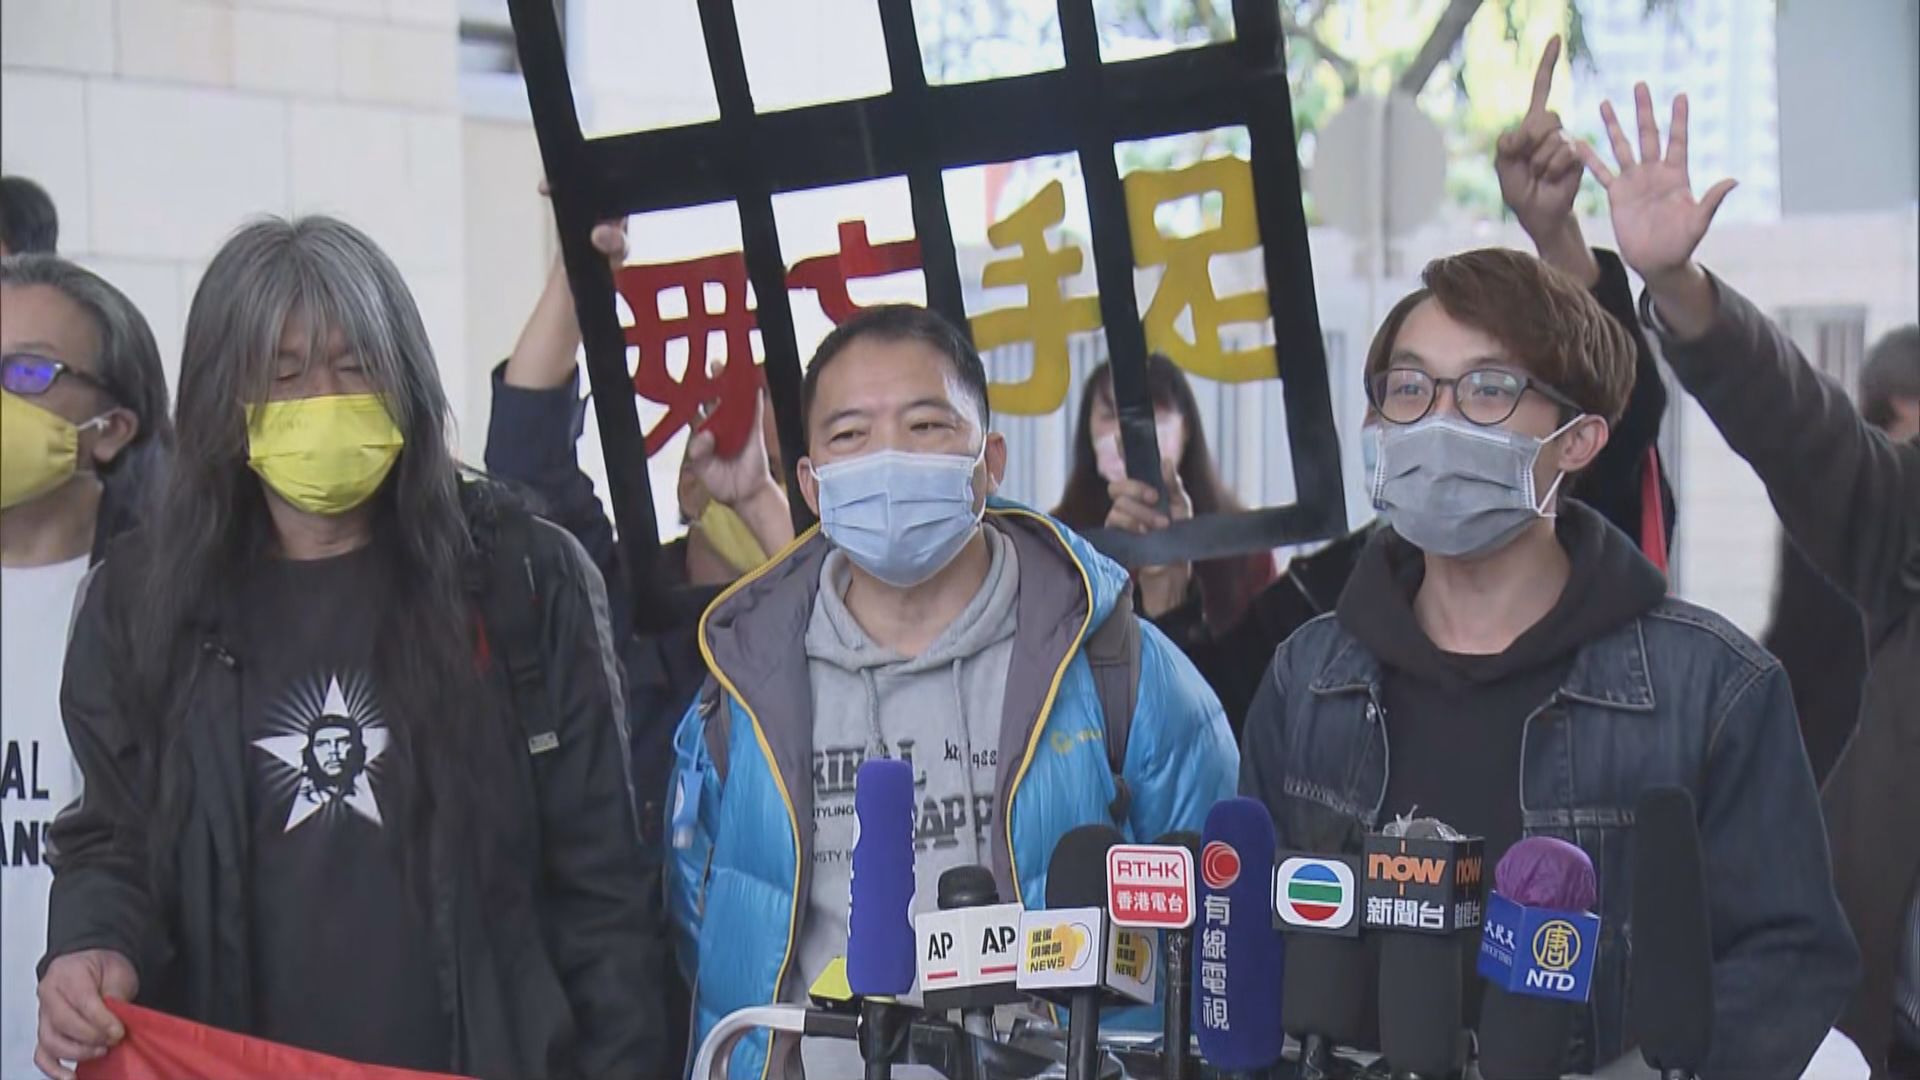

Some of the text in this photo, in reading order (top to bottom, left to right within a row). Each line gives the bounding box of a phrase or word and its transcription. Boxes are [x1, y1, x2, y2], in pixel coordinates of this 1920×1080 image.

[812, 804, 854, 818] TYLING
[1117, 860, 1179, 879] RTHK
[1369, 853, 1446, 885] now
[1117, 890, 1183, 913] 香港電台
[1367, 896, 1444, 929] 新聞台
[928, 931, 953, 961] AP
[981, 926, 1016, 955] AP
[1030, 956, 1065, 974] NEWS
[1202, 894, 1231, 1031] 有線電視
[1526, 968, 1575, 991] NTD
